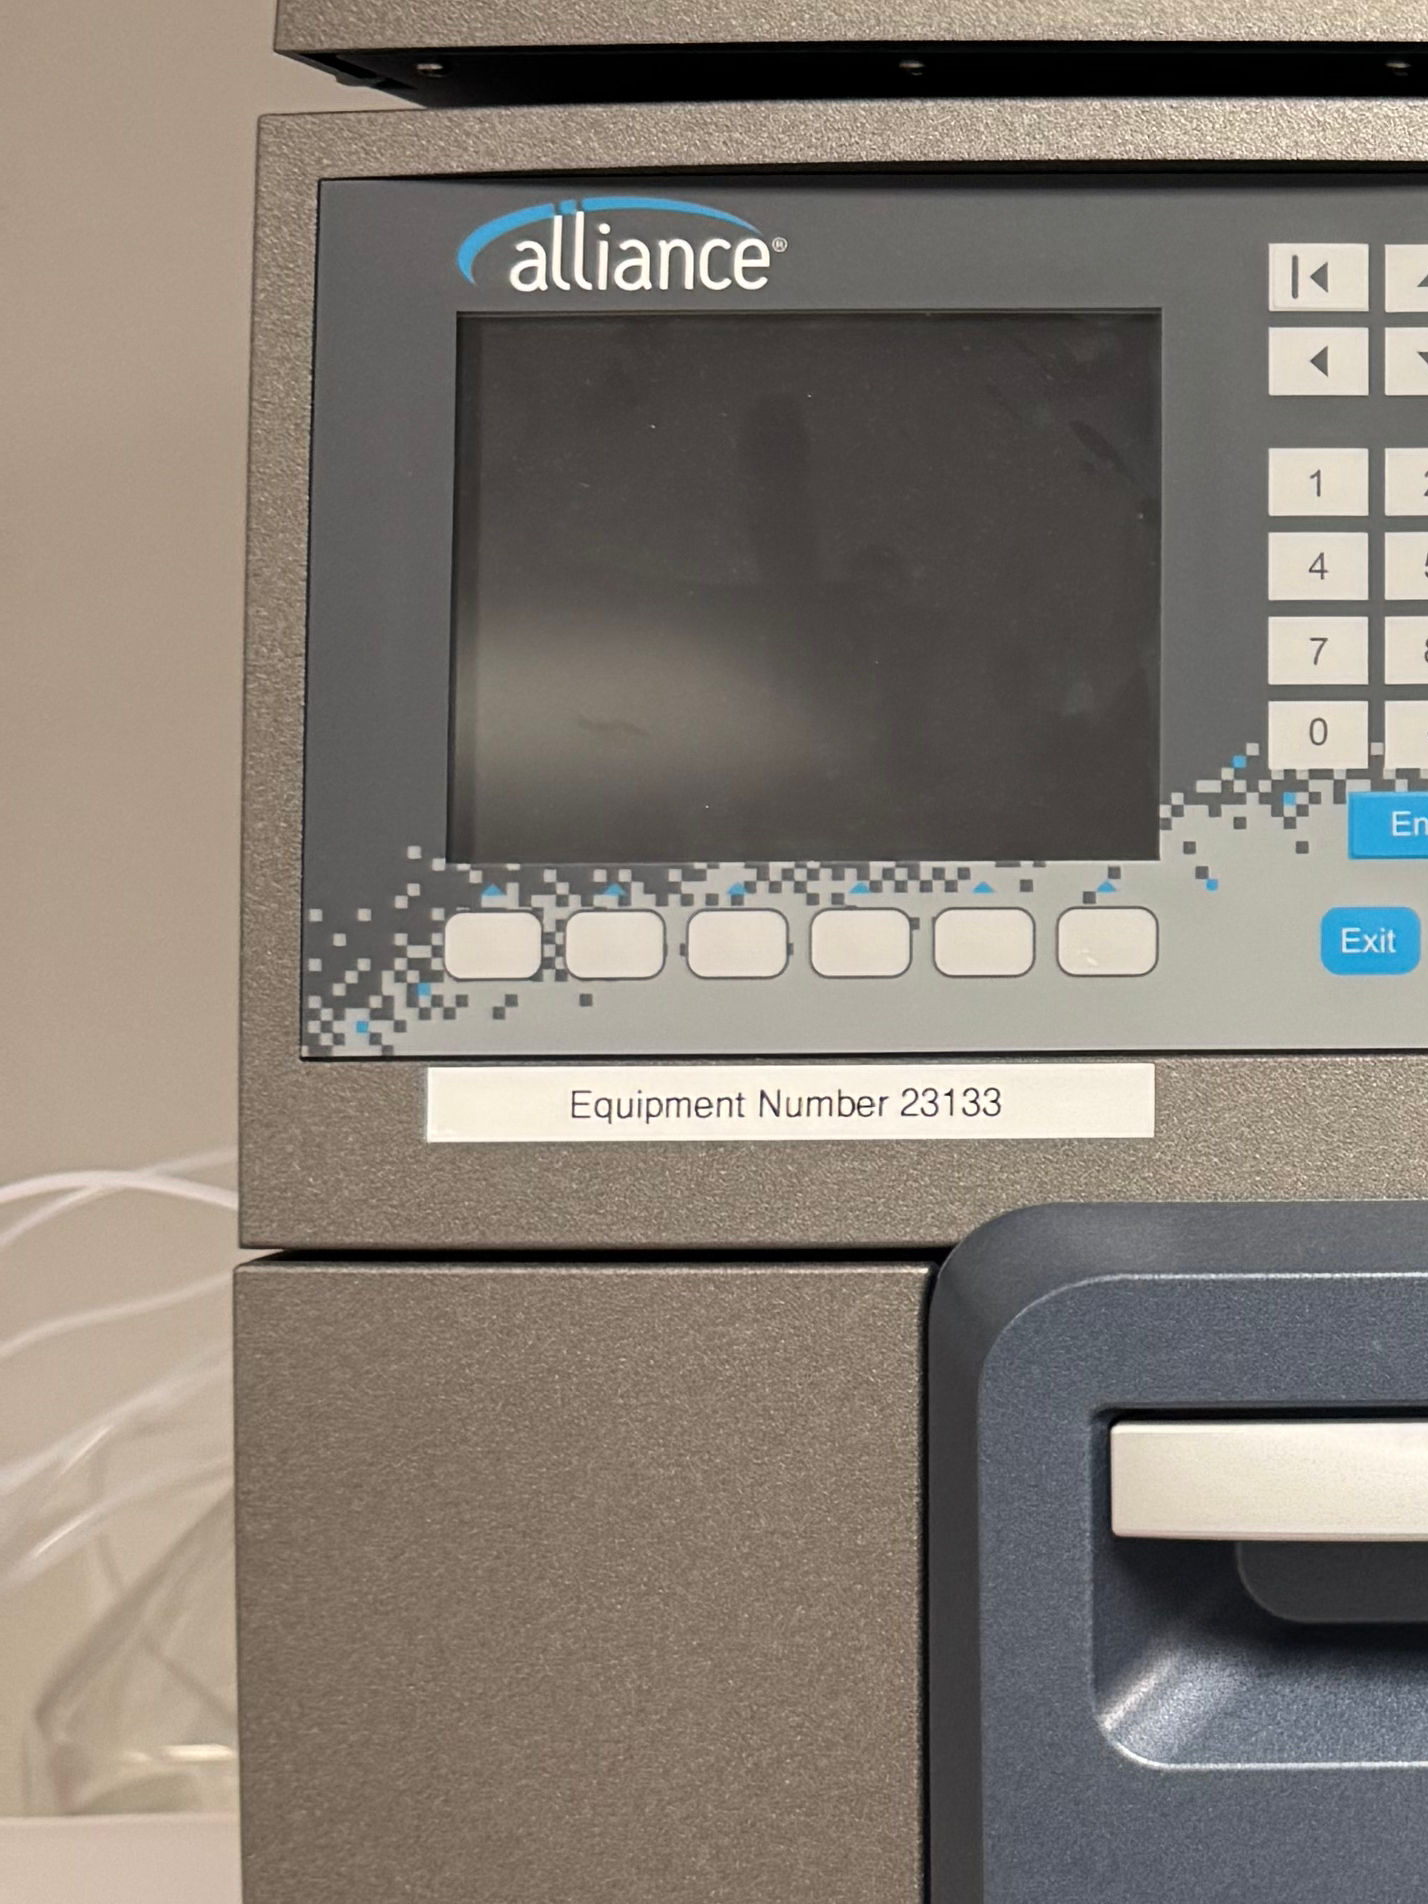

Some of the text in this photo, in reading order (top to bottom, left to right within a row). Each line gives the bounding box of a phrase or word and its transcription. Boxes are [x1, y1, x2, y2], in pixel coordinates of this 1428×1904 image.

[1308, 469, 1323, 498] 1
[1308, 552, 1329, 581] 4
[1309, 637, 1329, 666] 7
[1309, 717, 1328, 746] 0
[1341, 927, 1396, 954] Exit
[571, 1087, 1002, 1125] Equipment Number 23133
